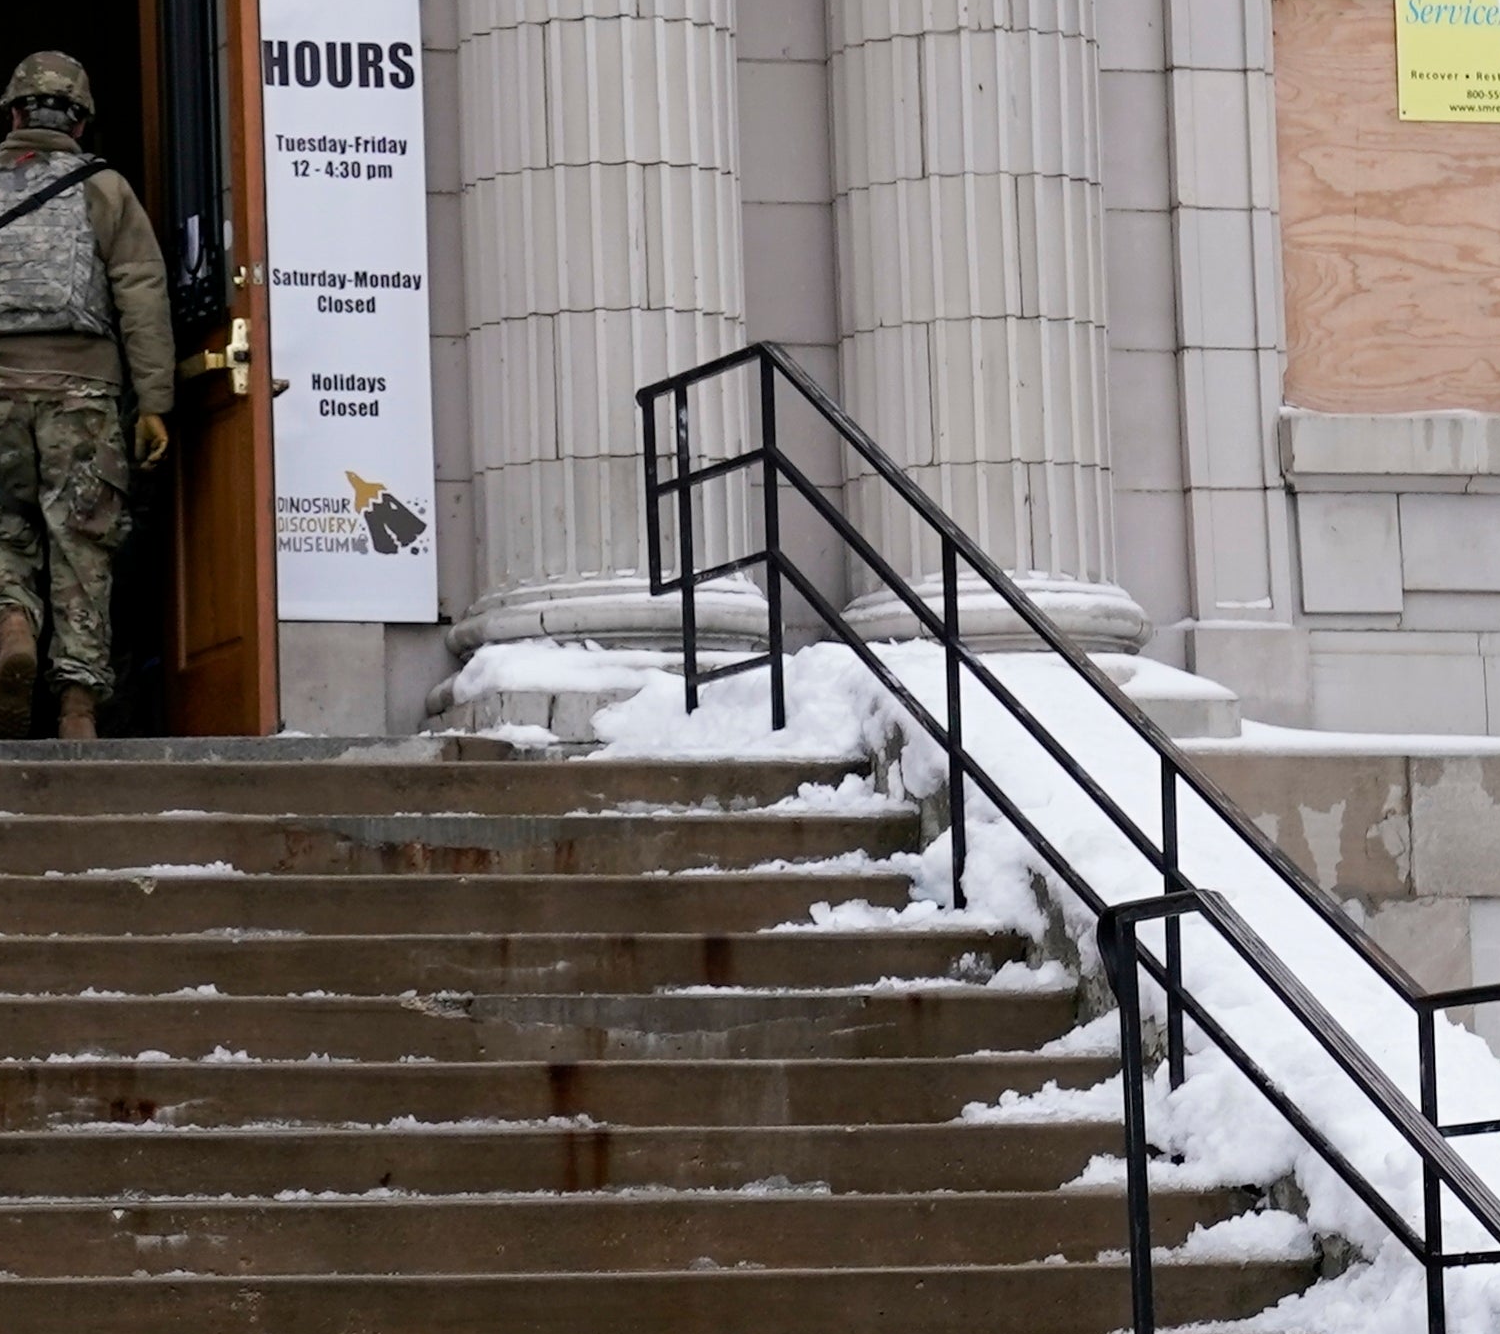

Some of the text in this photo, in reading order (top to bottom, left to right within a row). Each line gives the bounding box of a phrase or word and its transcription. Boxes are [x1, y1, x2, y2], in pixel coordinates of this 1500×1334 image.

[262, 40, 415, 89] HOURS
[1411, 70, 1459, 81] Recover
[276, 134, 408, 156] Tuesday-Friday
[292, 160, 310, 178] 12
[325, 161, 361, 179] 4:30
[367, 164, 393, 180] pm
[272, 268, 422, 291] Saturday-Monday
[317, 295, 377, 314] Closed
[311, 373, 387, 393] Holidays
[319, 399, 379, 417] Closed
[278, 496, 351, 514] DINOSAUR
[278, 516, 358, 534] DISCOVERY
[278, 535, 350, 553] MUSEUM
